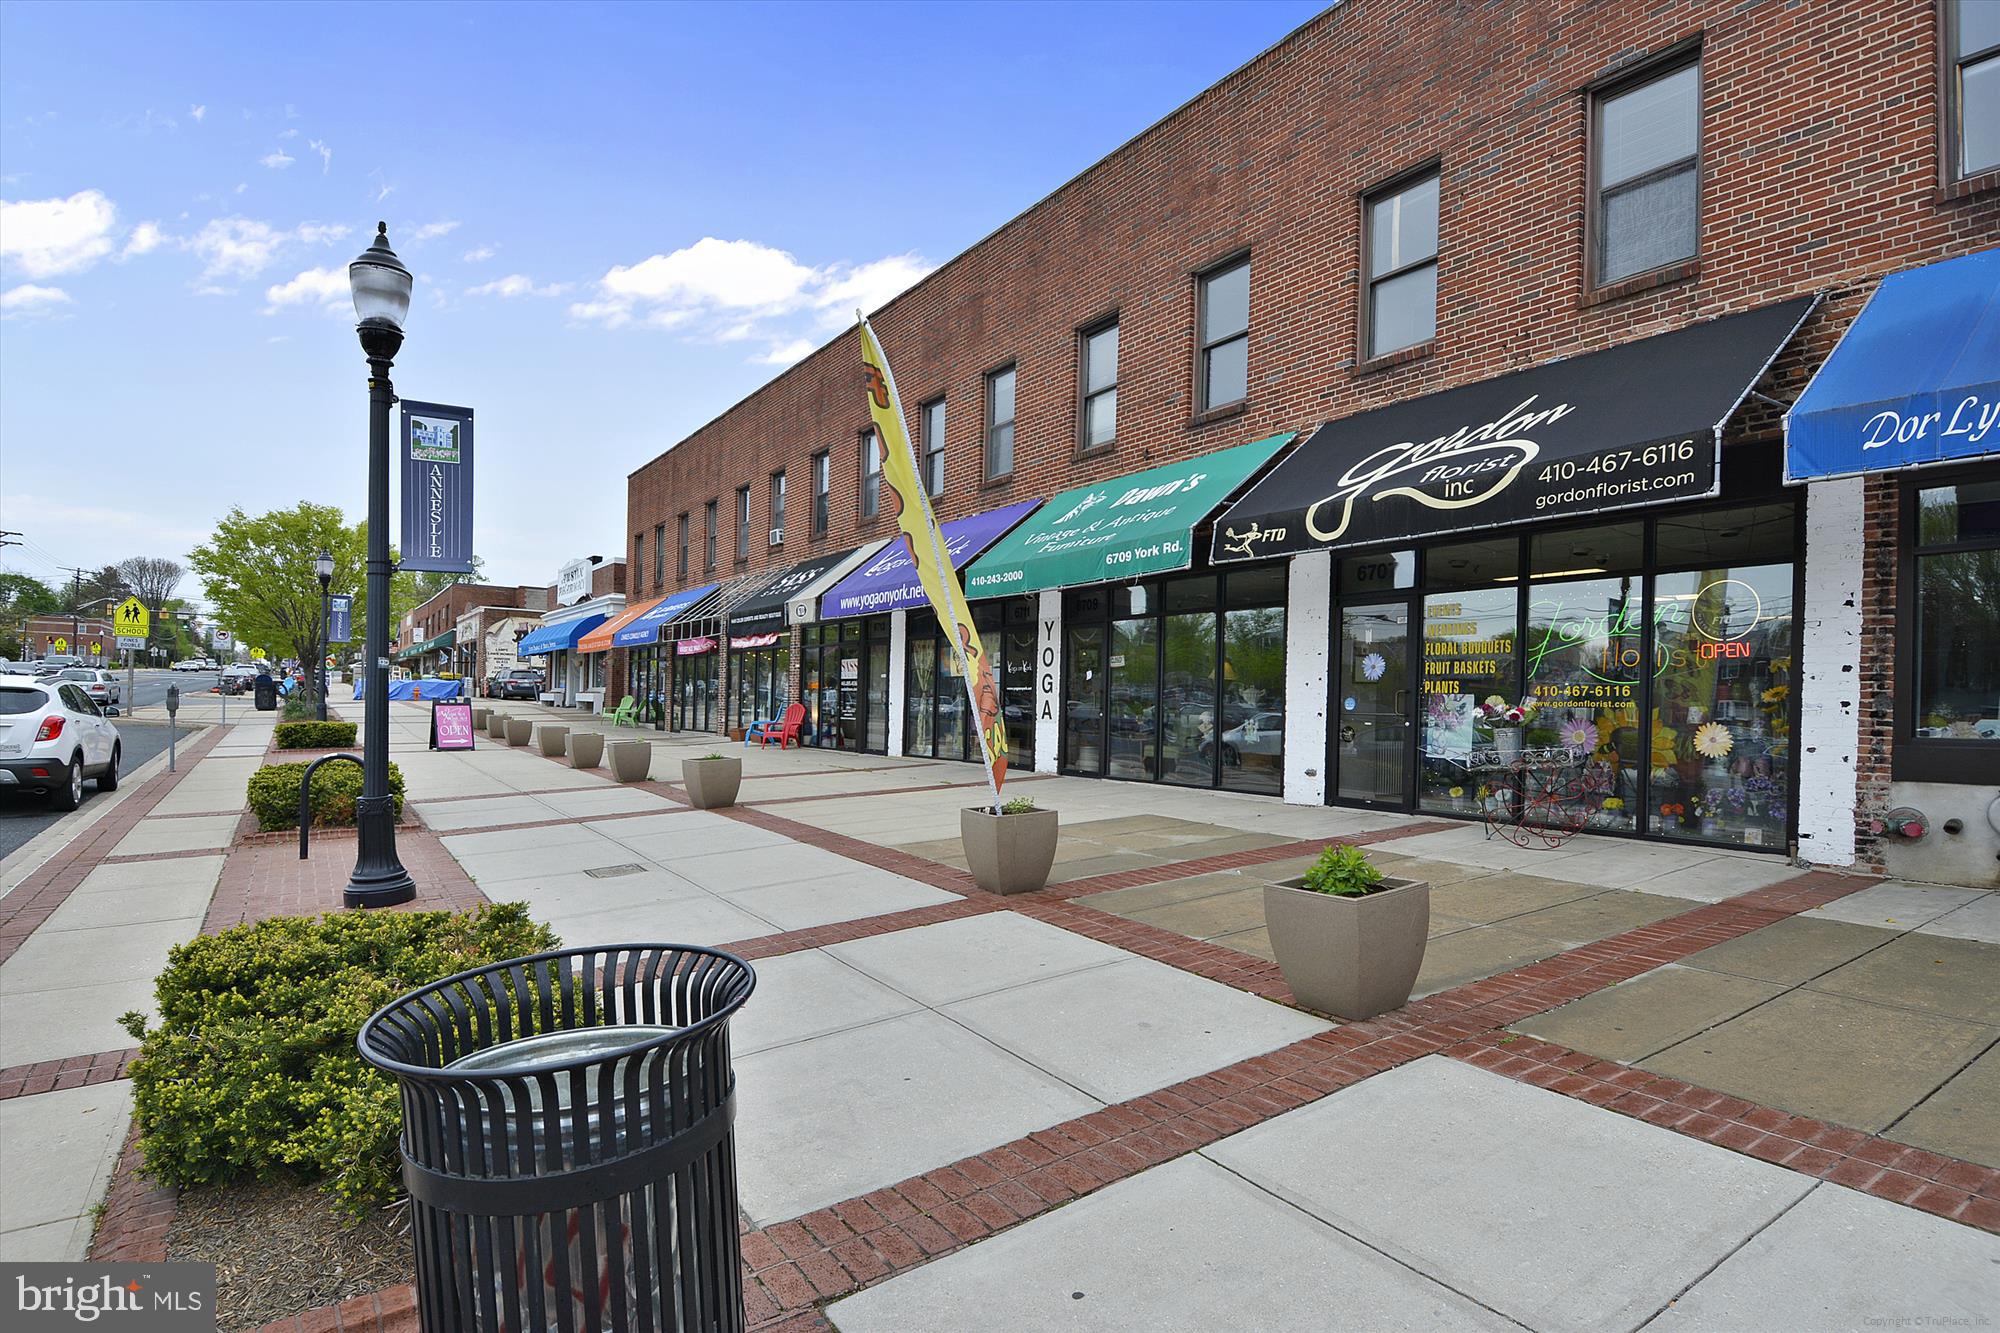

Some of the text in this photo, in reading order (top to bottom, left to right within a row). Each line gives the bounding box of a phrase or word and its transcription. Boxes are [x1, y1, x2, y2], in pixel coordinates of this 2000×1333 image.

[1862, 396, 2000, 451] Dor Ly
[1420, 452, 1518, 484] florist
[1537, 439, 1695, 483] 410-467-6116
[1109, 473, 1208, 510] Dawn's
[1444, 479, 1475, 498] inc
[1535, 471, 1695, 510] gordonflorist.com
[429, 464, 444, 559] ANNESLIE
[1024, 527, 1081, 546] Vintage
[1102, 506, 1177, 531] Antique
[1261, 528, 1287, 543] FTD
[1038, 532, 1117, 554] Furniture
[1105, 540, 1183, 565] 6709 York Rd.
[971, 570, 1024, 587] 410-243-2000
[840, 583, 925, 611] www.yogaonyork.net
[1427, 602, 1462, 618] EVENTS
[116, 626, 146, 636] SCHOOL
[1426, 621, 1478, 637] WEDDINGS
[1424, 639, 1512, 656] FLORAL BOUQUETS
[1601, 637, 1710, 673] floist
[1701, 642, 1751, 659] OPEN
[1041, 620, 1055, 720] YOGA
[1424, 659, 1497, 675] FRUIT BASKETS
[1424, 680, 1460, 694] PLANTS
[1534, 685, 1632, 697] 410-467-6116
[439, 725, 469, 736] OPEN
